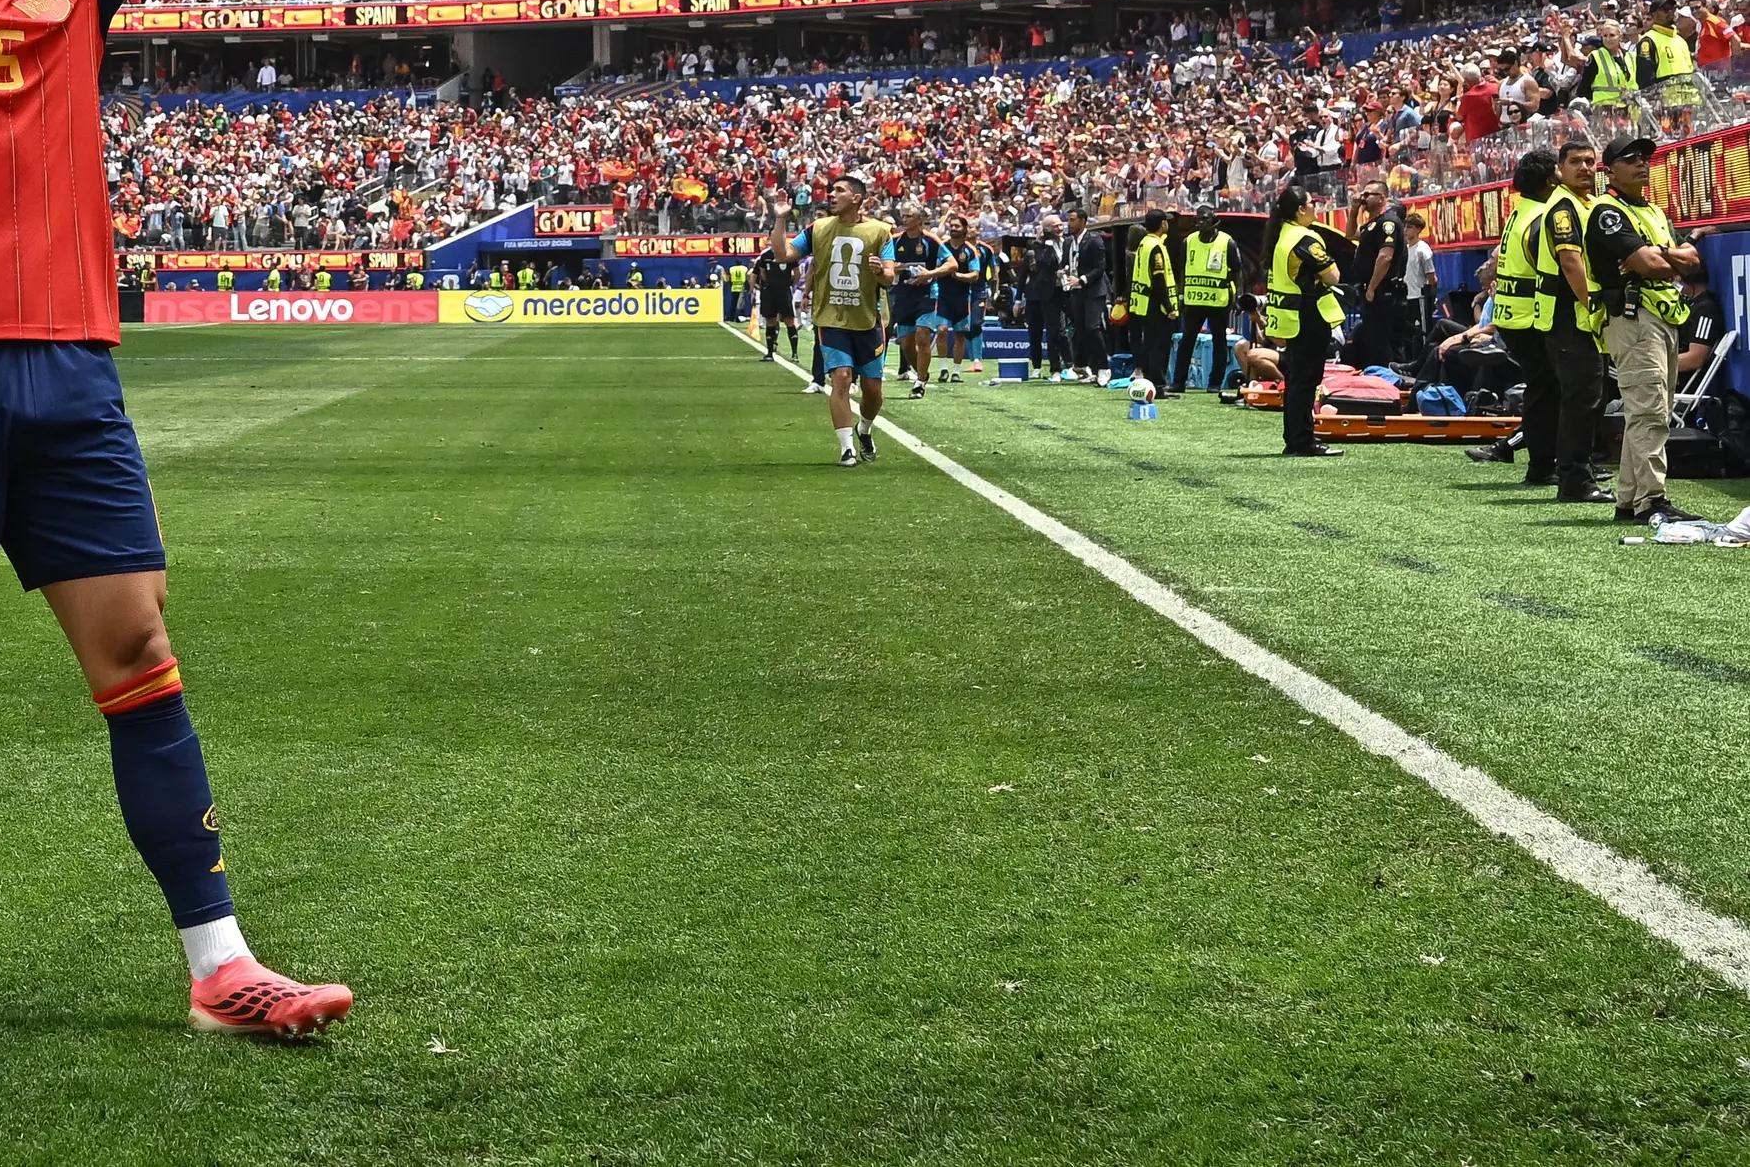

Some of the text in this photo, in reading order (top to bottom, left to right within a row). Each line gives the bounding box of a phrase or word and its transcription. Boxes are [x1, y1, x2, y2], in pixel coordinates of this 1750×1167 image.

[204, 9, 259, 28] GOAL!
[356, 6, 396, 26] SPAIN
[539, 212, 591, 234] GOAL!
[504, 241, 517, 249] FIFA
[640, 238, 672, 254] GOAL!
[728, 237, 754, 254] SPAIN
[369, 253, 397, 267] SPAIN
[837, 278, 852, 286] FIFA
[1185, 277, 1221, 288] SECURITY
[829, 297, 861, 306] 2026
[1187, 291, 1217, 302] 07924
[230, 293, 353, 322] Lenovo
[522, 292, 700, 317] mercado libre
[986, 340, 1013, 349] WORLD
[1014, 341, 1030, 350] CUP
